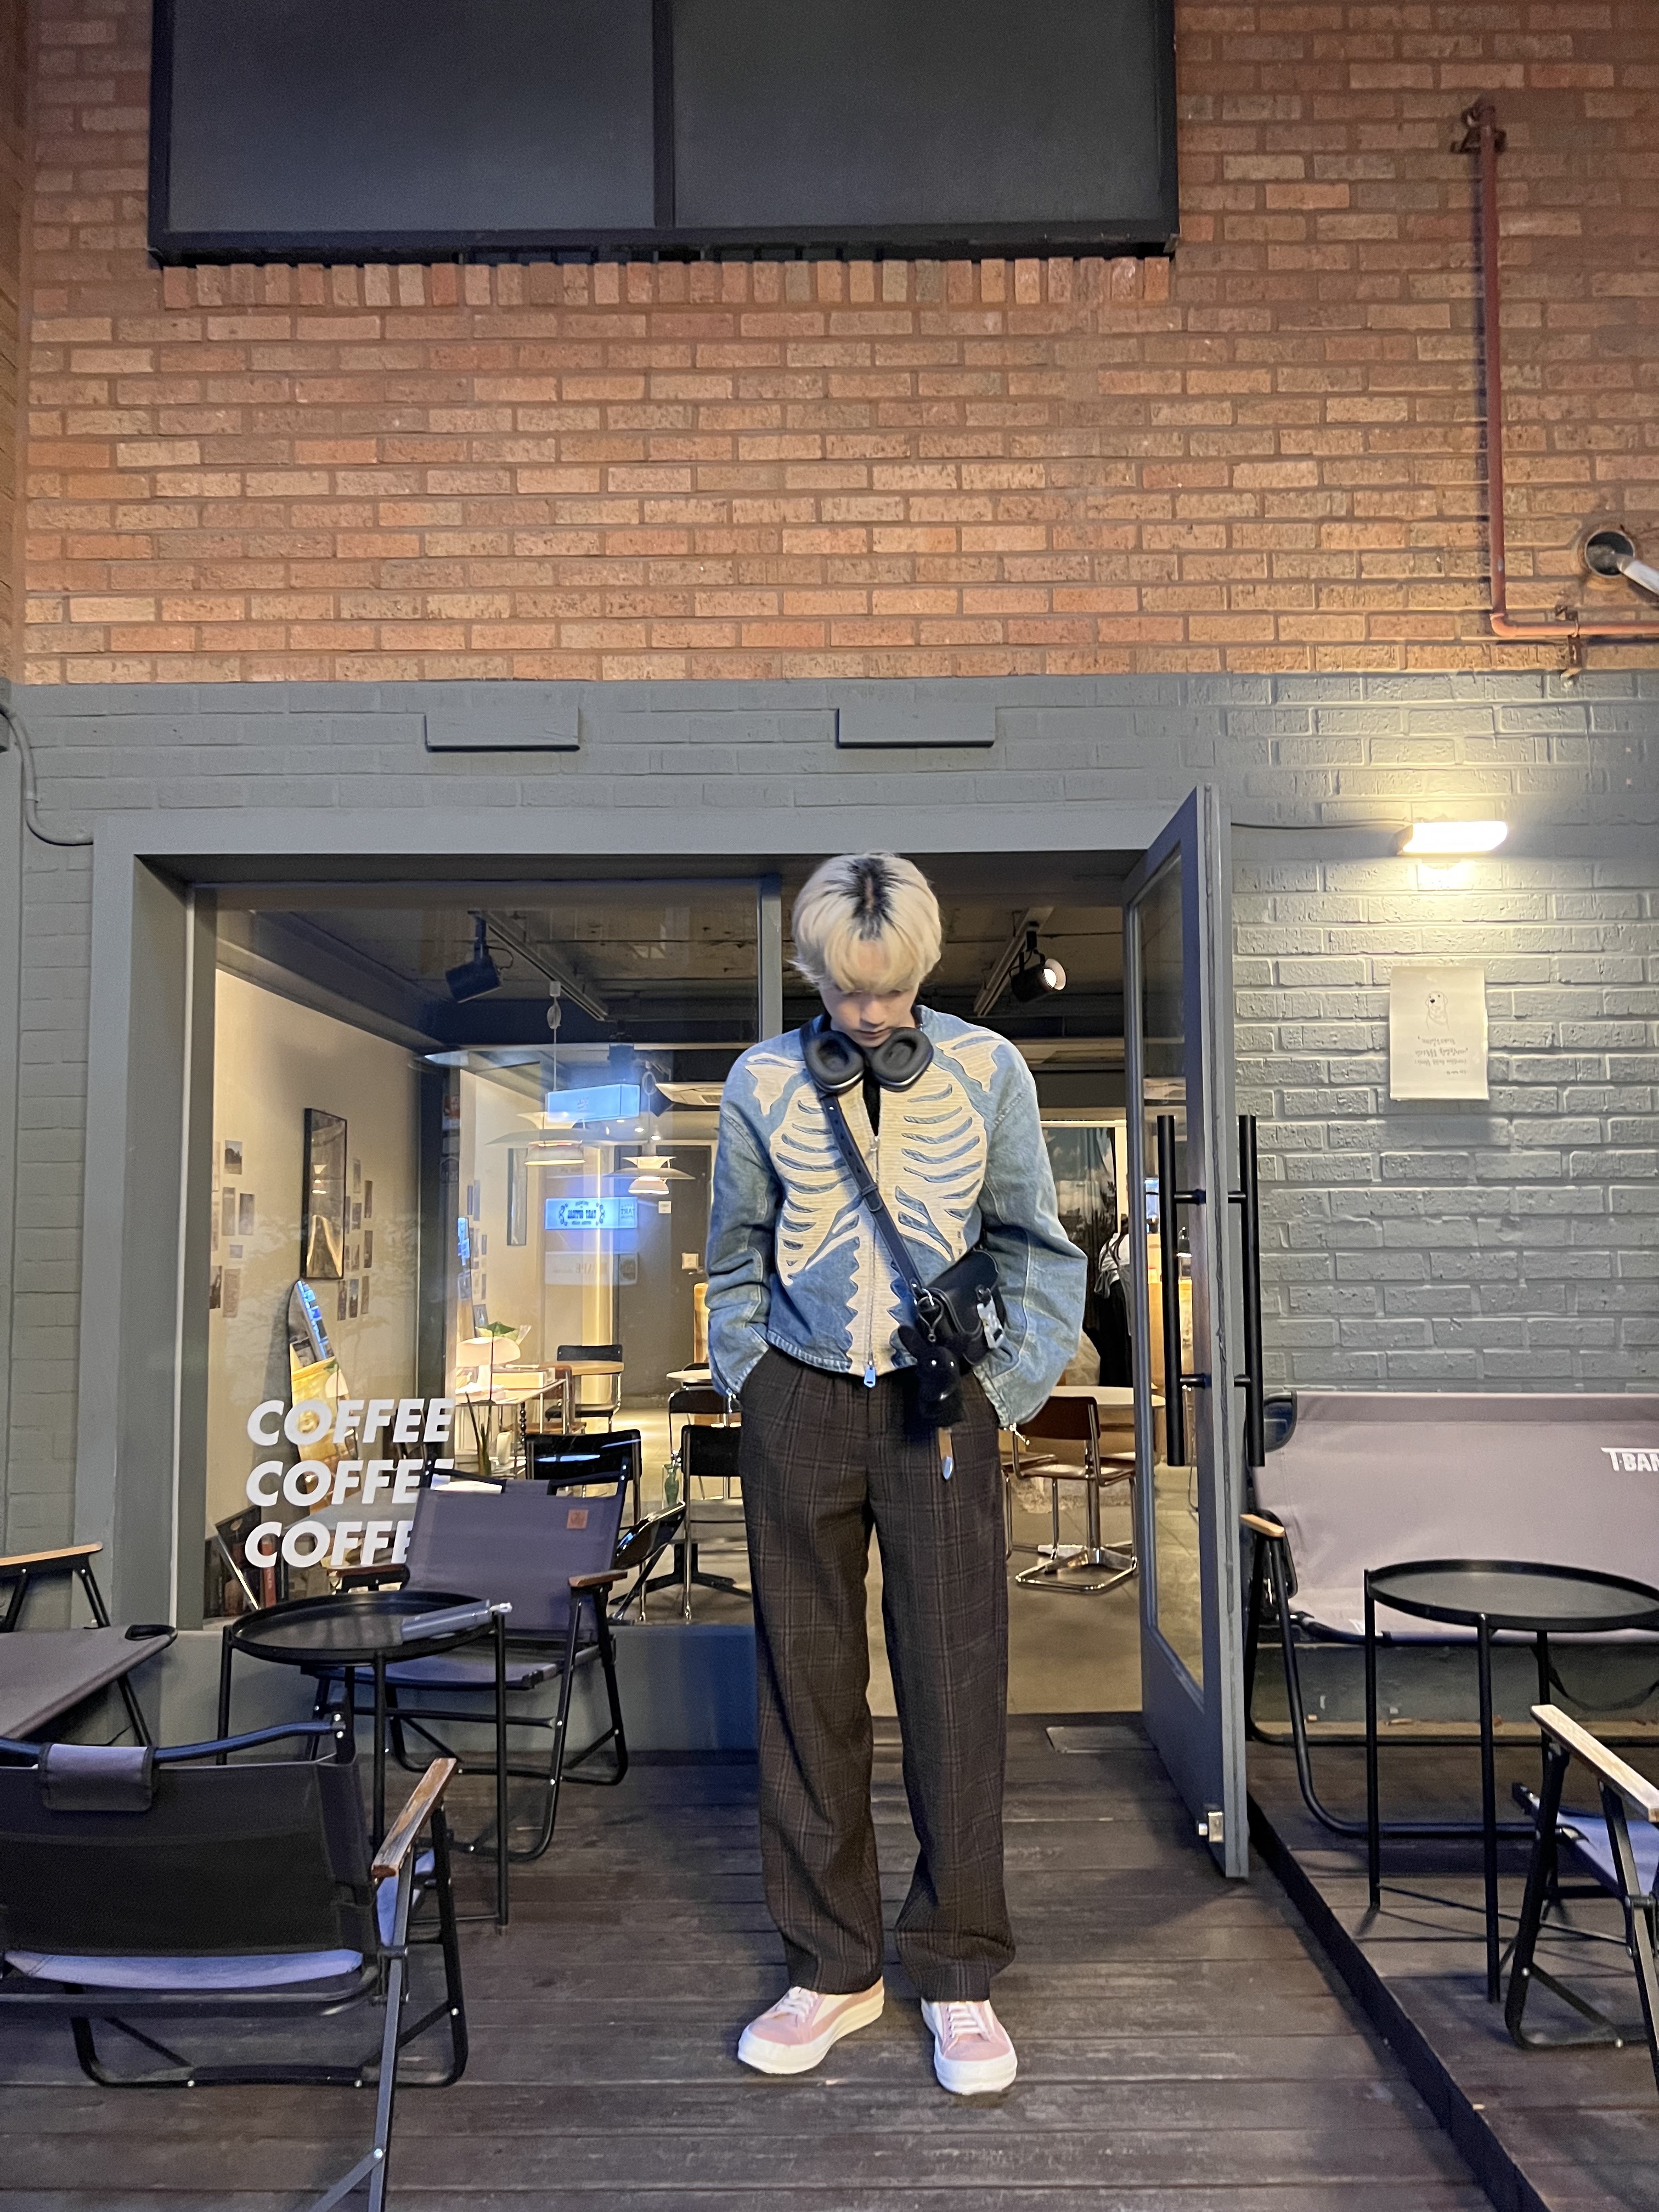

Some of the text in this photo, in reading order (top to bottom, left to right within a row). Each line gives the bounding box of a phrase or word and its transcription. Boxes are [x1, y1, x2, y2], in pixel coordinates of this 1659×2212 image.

[247, 1398, 454, 1447] COFFEE
[246, 1459, 454, 1507] COFFEE
[245, 1521, 414, 1568] COFFE
